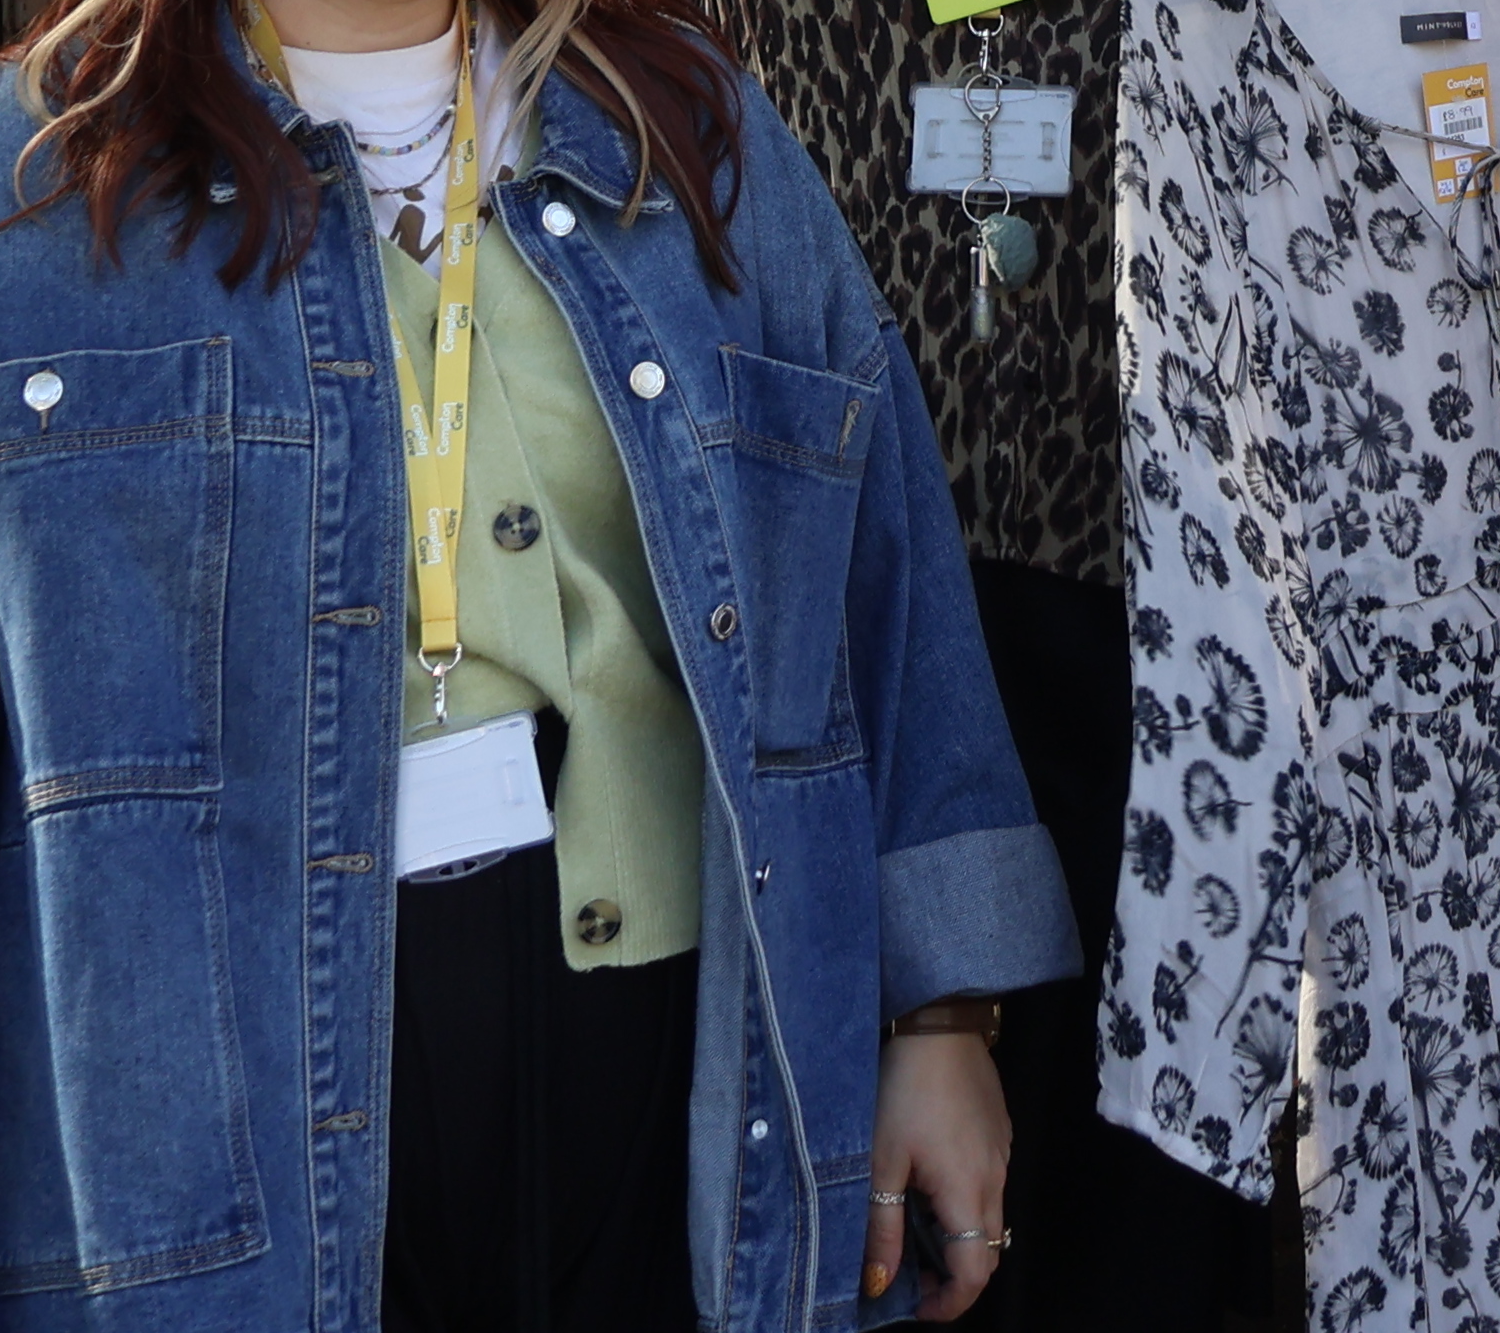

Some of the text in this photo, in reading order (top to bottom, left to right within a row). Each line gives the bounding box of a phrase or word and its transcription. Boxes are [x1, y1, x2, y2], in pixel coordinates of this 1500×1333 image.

[1447, 75, 1484, 89] Compton
[1465, 87, 1484, 98] Care
[452, 140, 469, 186] Compton
[463, 138, 474, 163] Care
[447, 222, 468, 266] Compton
[462, 223, 474, 247] Care
[442, 302, 463, 354] Compton
[457, 305, 469, 329] Care
[411, 404, 429, 456] Compton
[436, 402, 457, 455] Compton
[451, 402, 463, 431] Care
[405, 430, 416, 456] Care
[427, 507, 445, 564] Compton
[418, 536, 429, 564] Care
